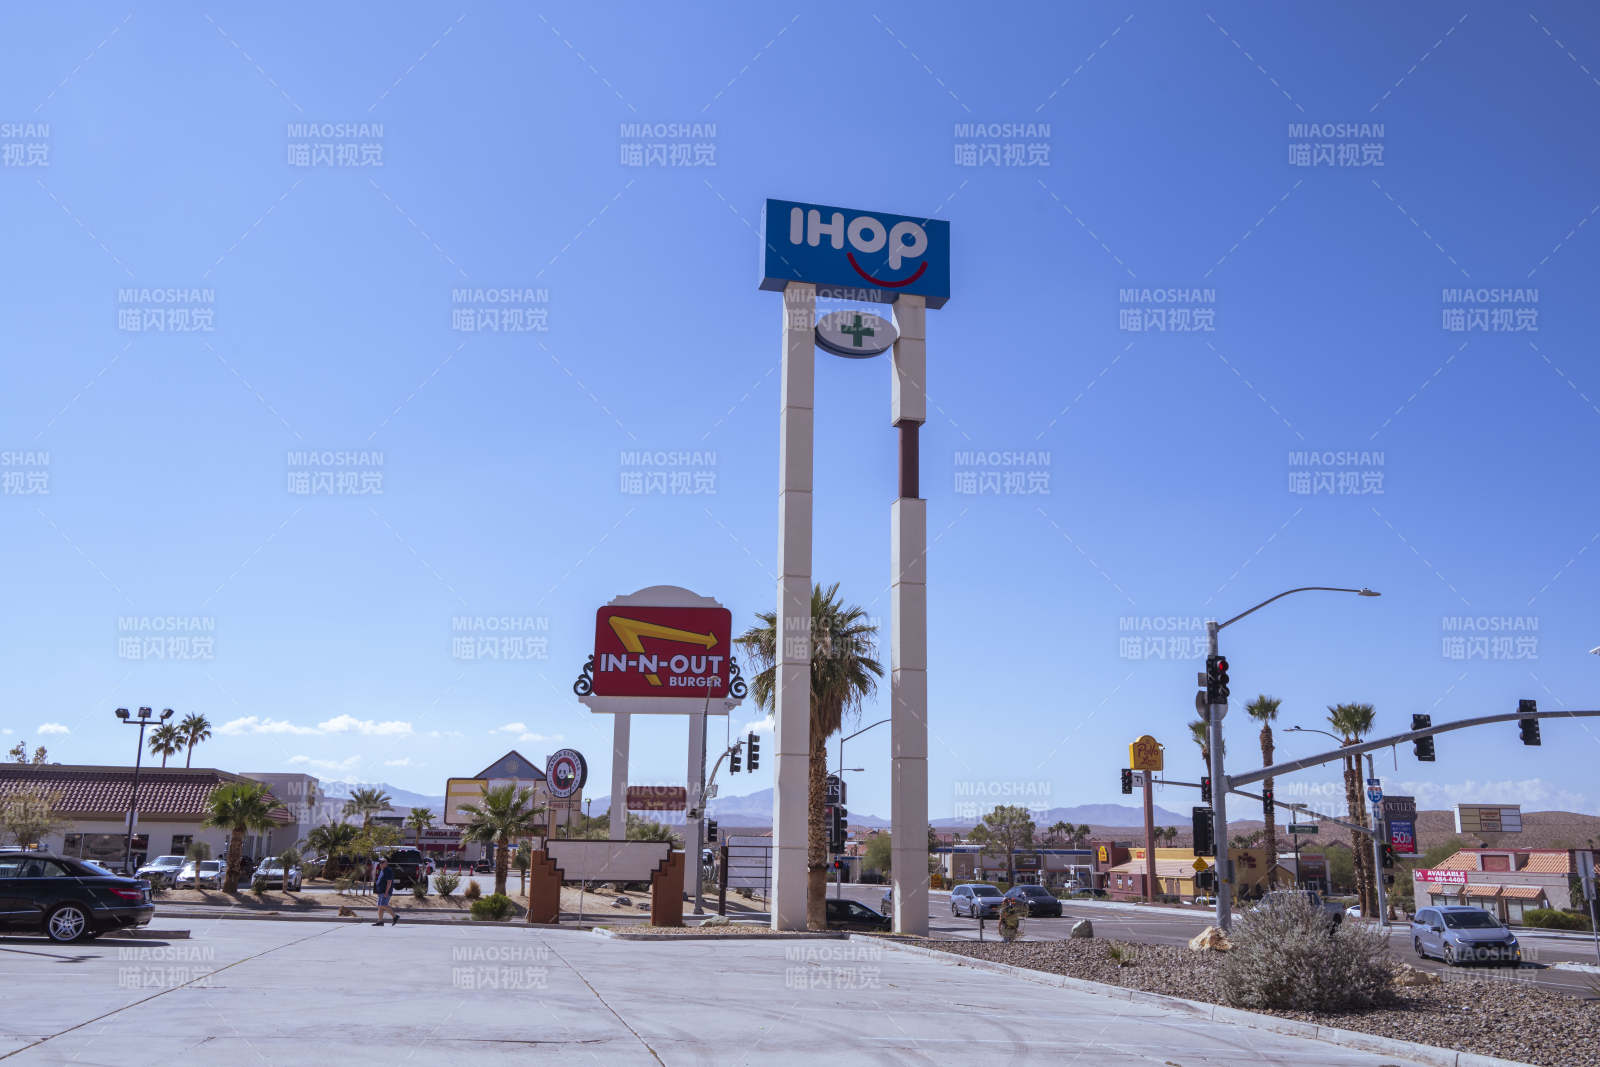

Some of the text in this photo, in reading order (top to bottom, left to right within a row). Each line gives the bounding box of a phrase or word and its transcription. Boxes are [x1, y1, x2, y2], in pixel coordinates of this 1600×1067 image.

[600, 653, 724, 674] IN-N-OUT
[669, 676, 722, 687] BURGER
[1371, 792, 1381, 800] 15
